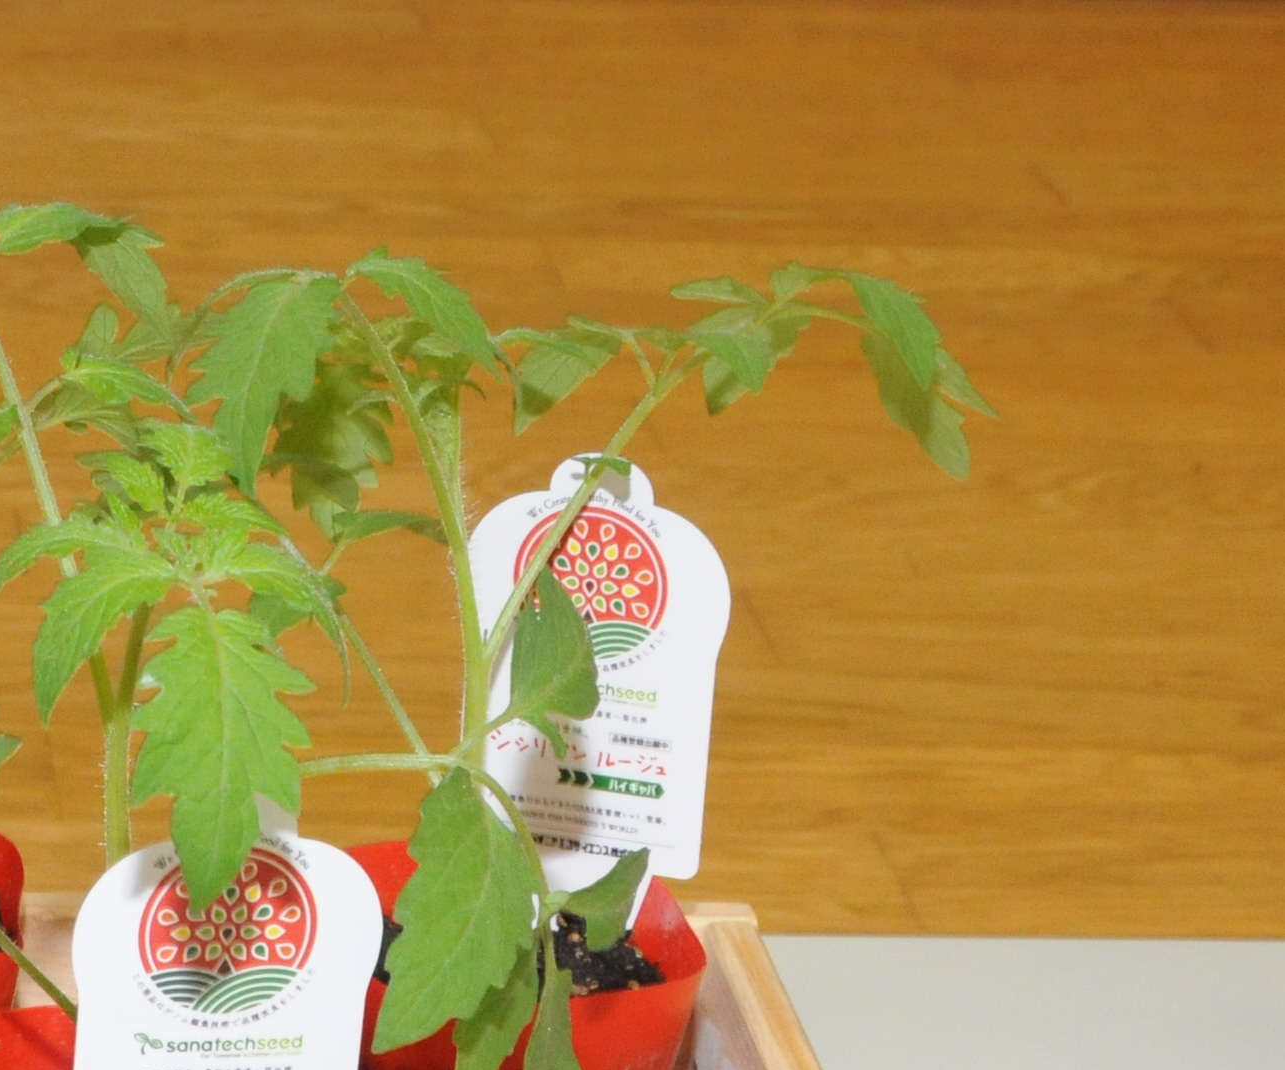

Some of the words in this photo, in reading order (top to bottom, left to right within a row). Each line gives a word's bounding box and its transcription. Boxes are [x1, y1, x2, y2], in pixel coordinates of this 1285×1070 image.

[490, 729, 587, 760] シシリン
[596, 750, 668, 776] ルージュ
[165, 1034, 304, 1055] sanatechseed
